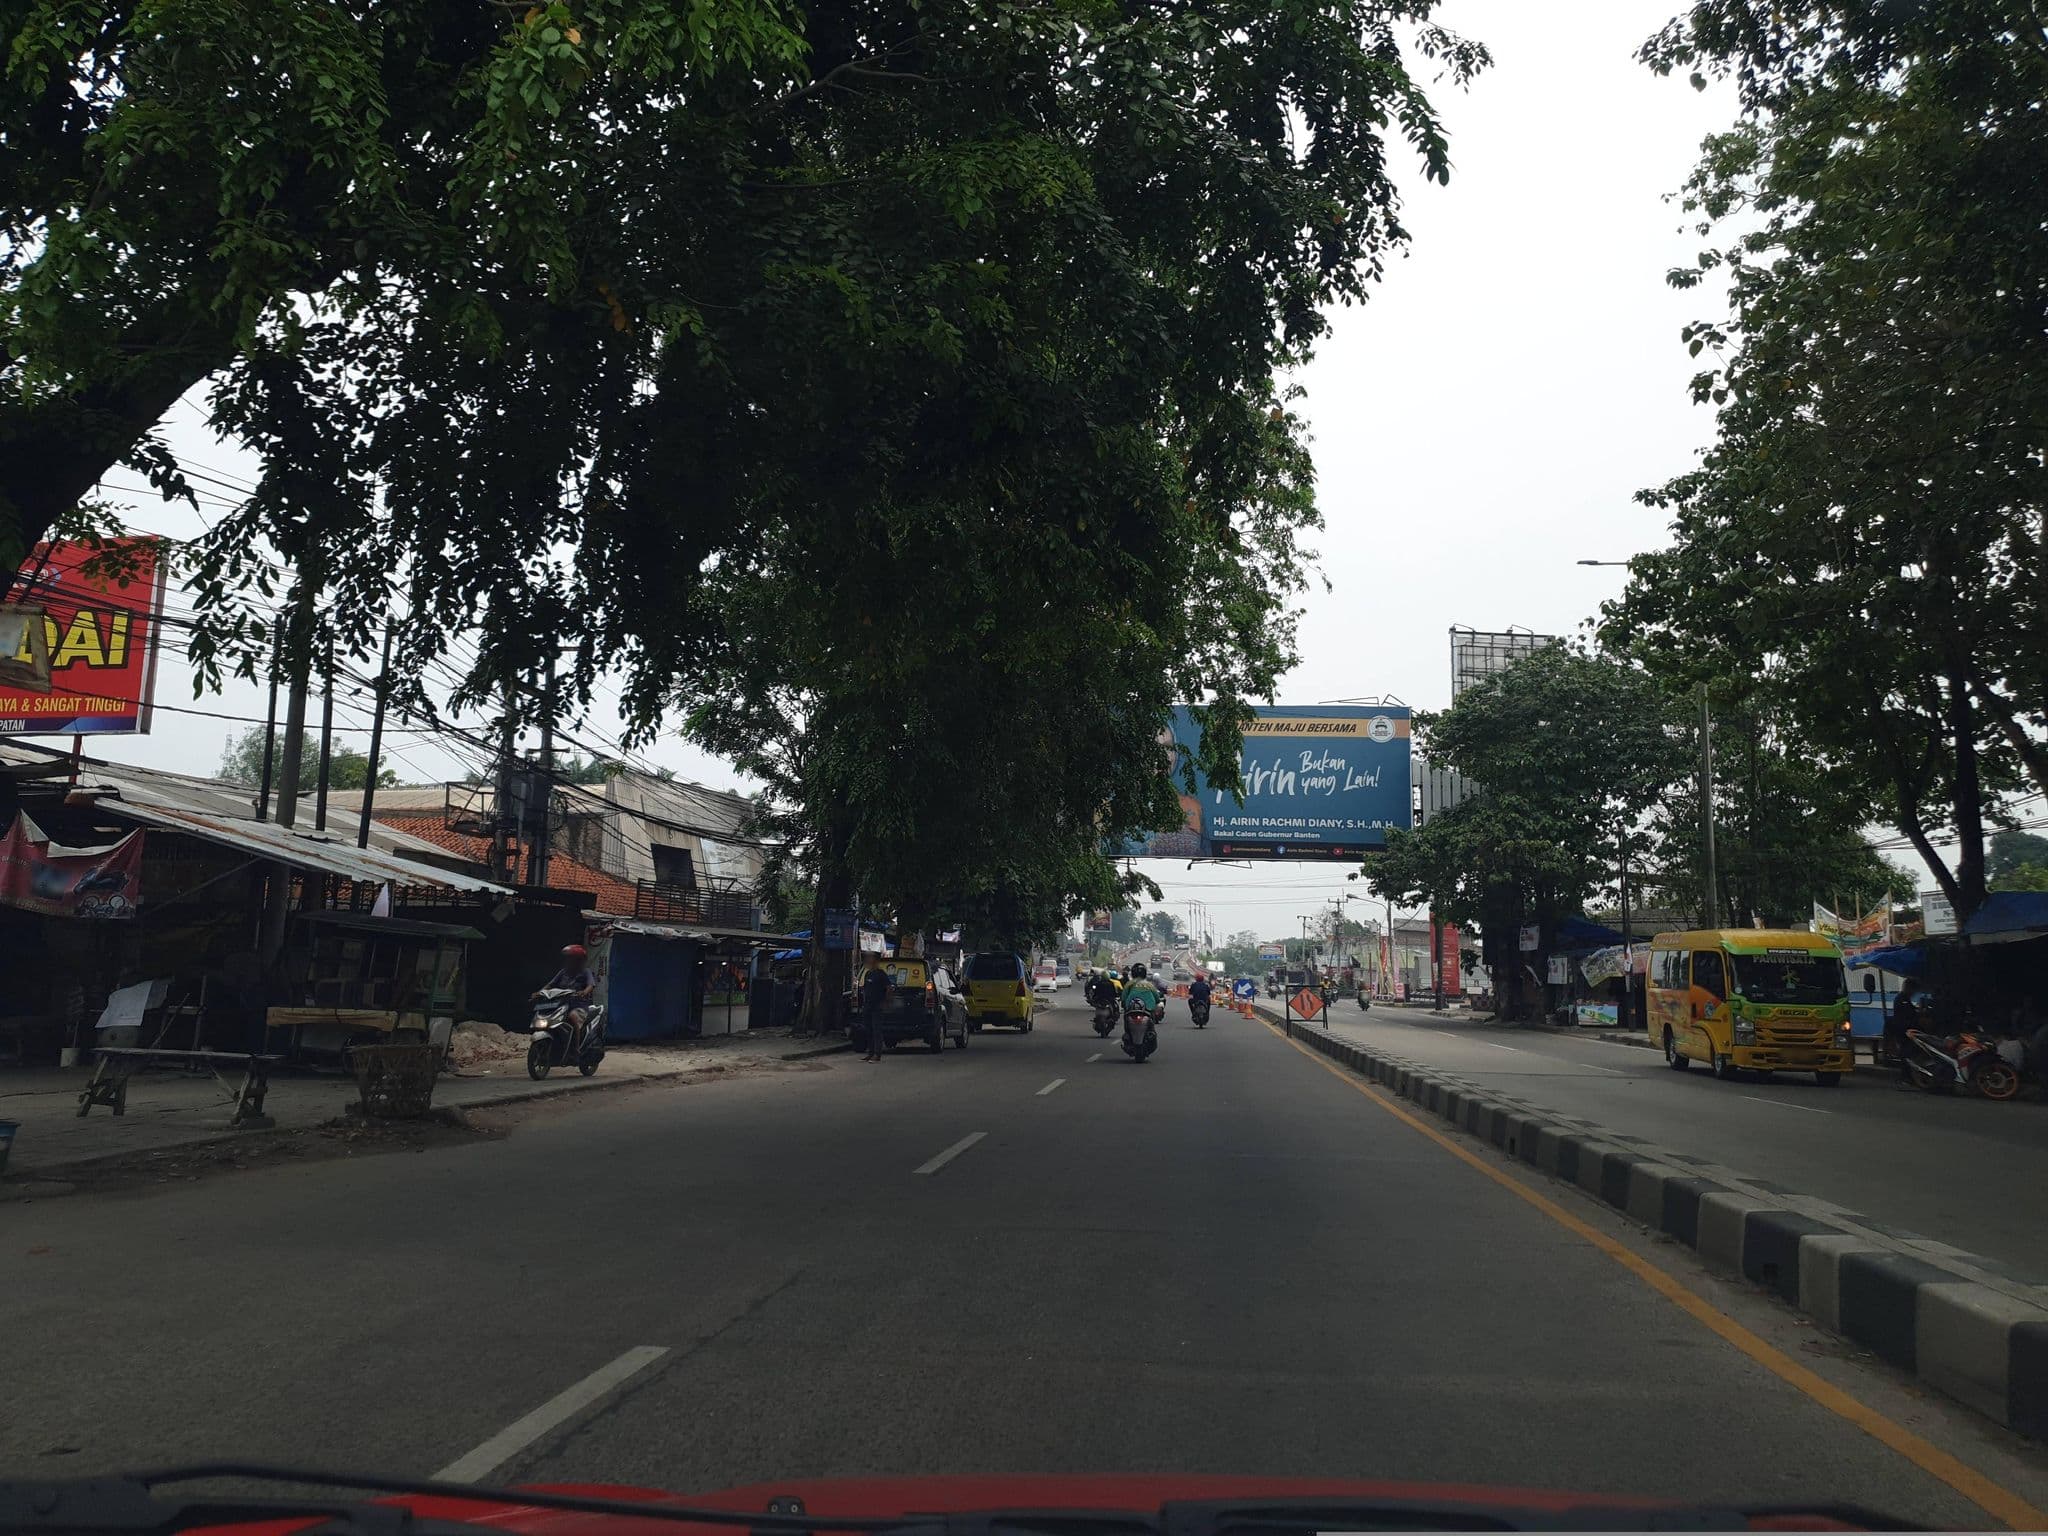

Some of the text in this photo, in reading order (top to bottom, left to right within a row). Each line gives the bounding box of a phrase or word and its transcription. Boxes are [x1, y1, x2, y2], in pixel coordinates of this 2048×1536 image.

[21, 698, 30, 712] &
[34, 698, 82, 712] SANGAT
[85, 697, 126, 712] TINGGI
[1238, 722, 1357, 733] ANTEN MAJU BERSAMA
[1300, 749, 1346, 773] Bukan
[1301, 766, 1381, 796] yang Lain!
[1213, 817, 1227, 827] Hj.
[1230, 818, 1260, 827] AIRIN
[1262, 818, 1306, 828] RACHMI
[1308, 819, 1345, 829] DIANY,
